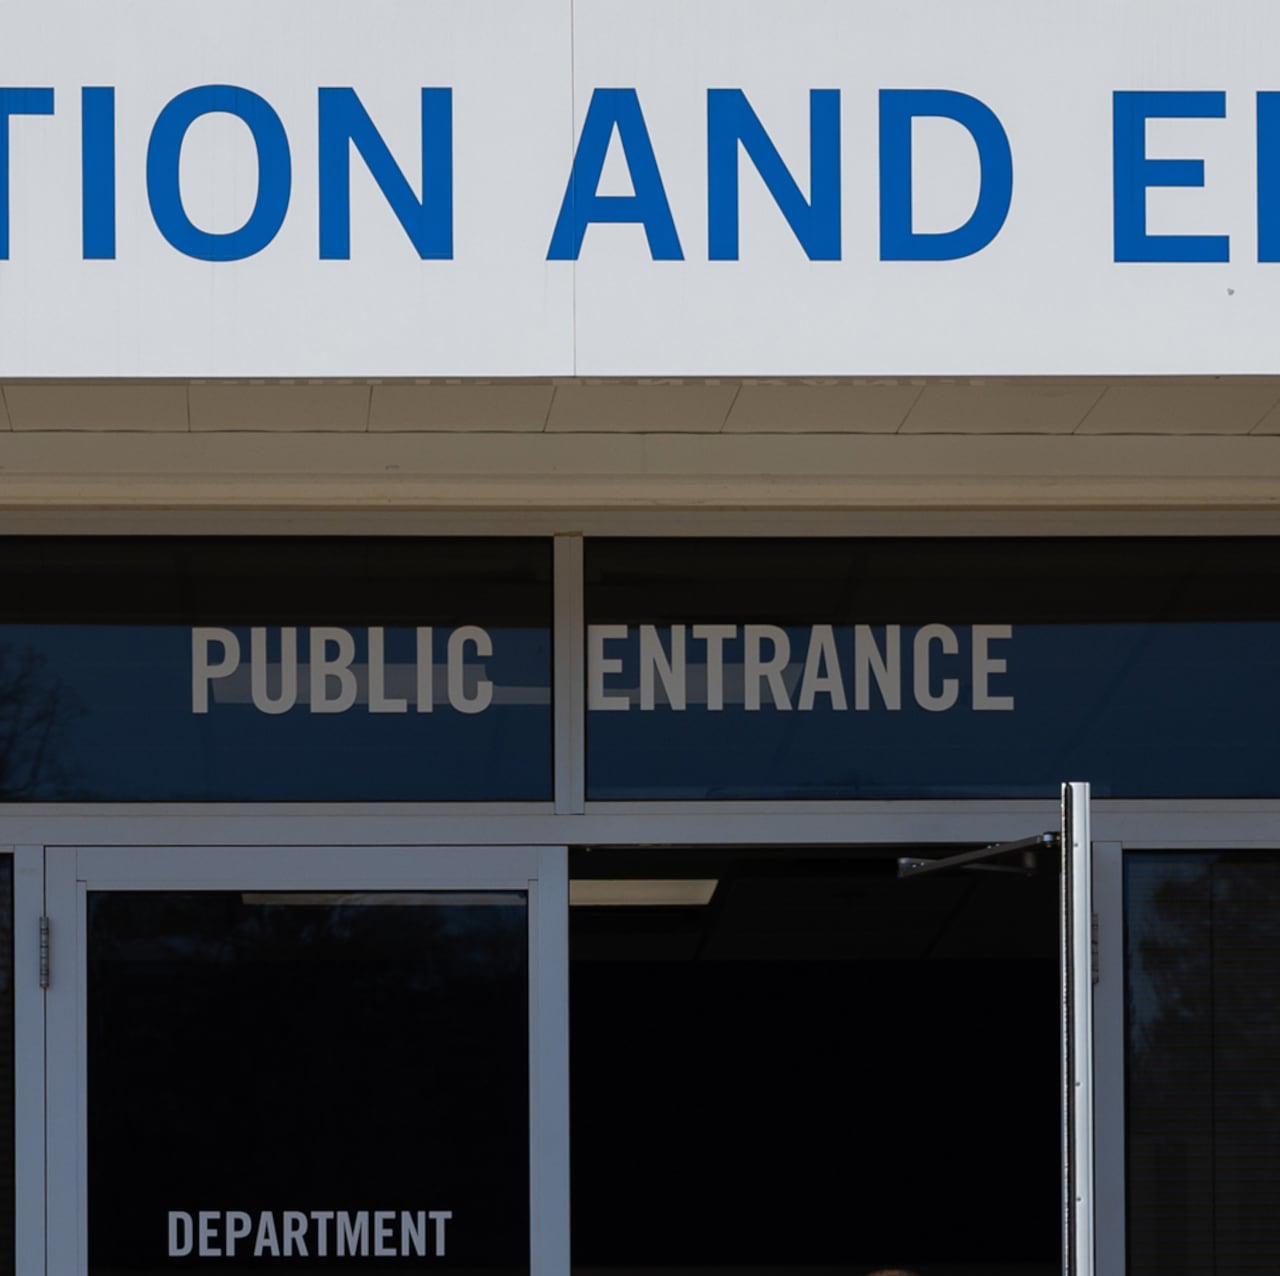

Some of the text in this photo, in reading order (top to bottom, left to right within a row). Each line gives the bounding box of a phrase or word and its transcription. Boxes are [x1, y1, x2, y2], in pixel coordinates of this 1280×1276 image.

[547, 89, 1013, 261] AND
[191, 622, 1015, 715] PUBLIC ENTRANCE
[167, 1210, 453, 1257] DEPARTMENT
